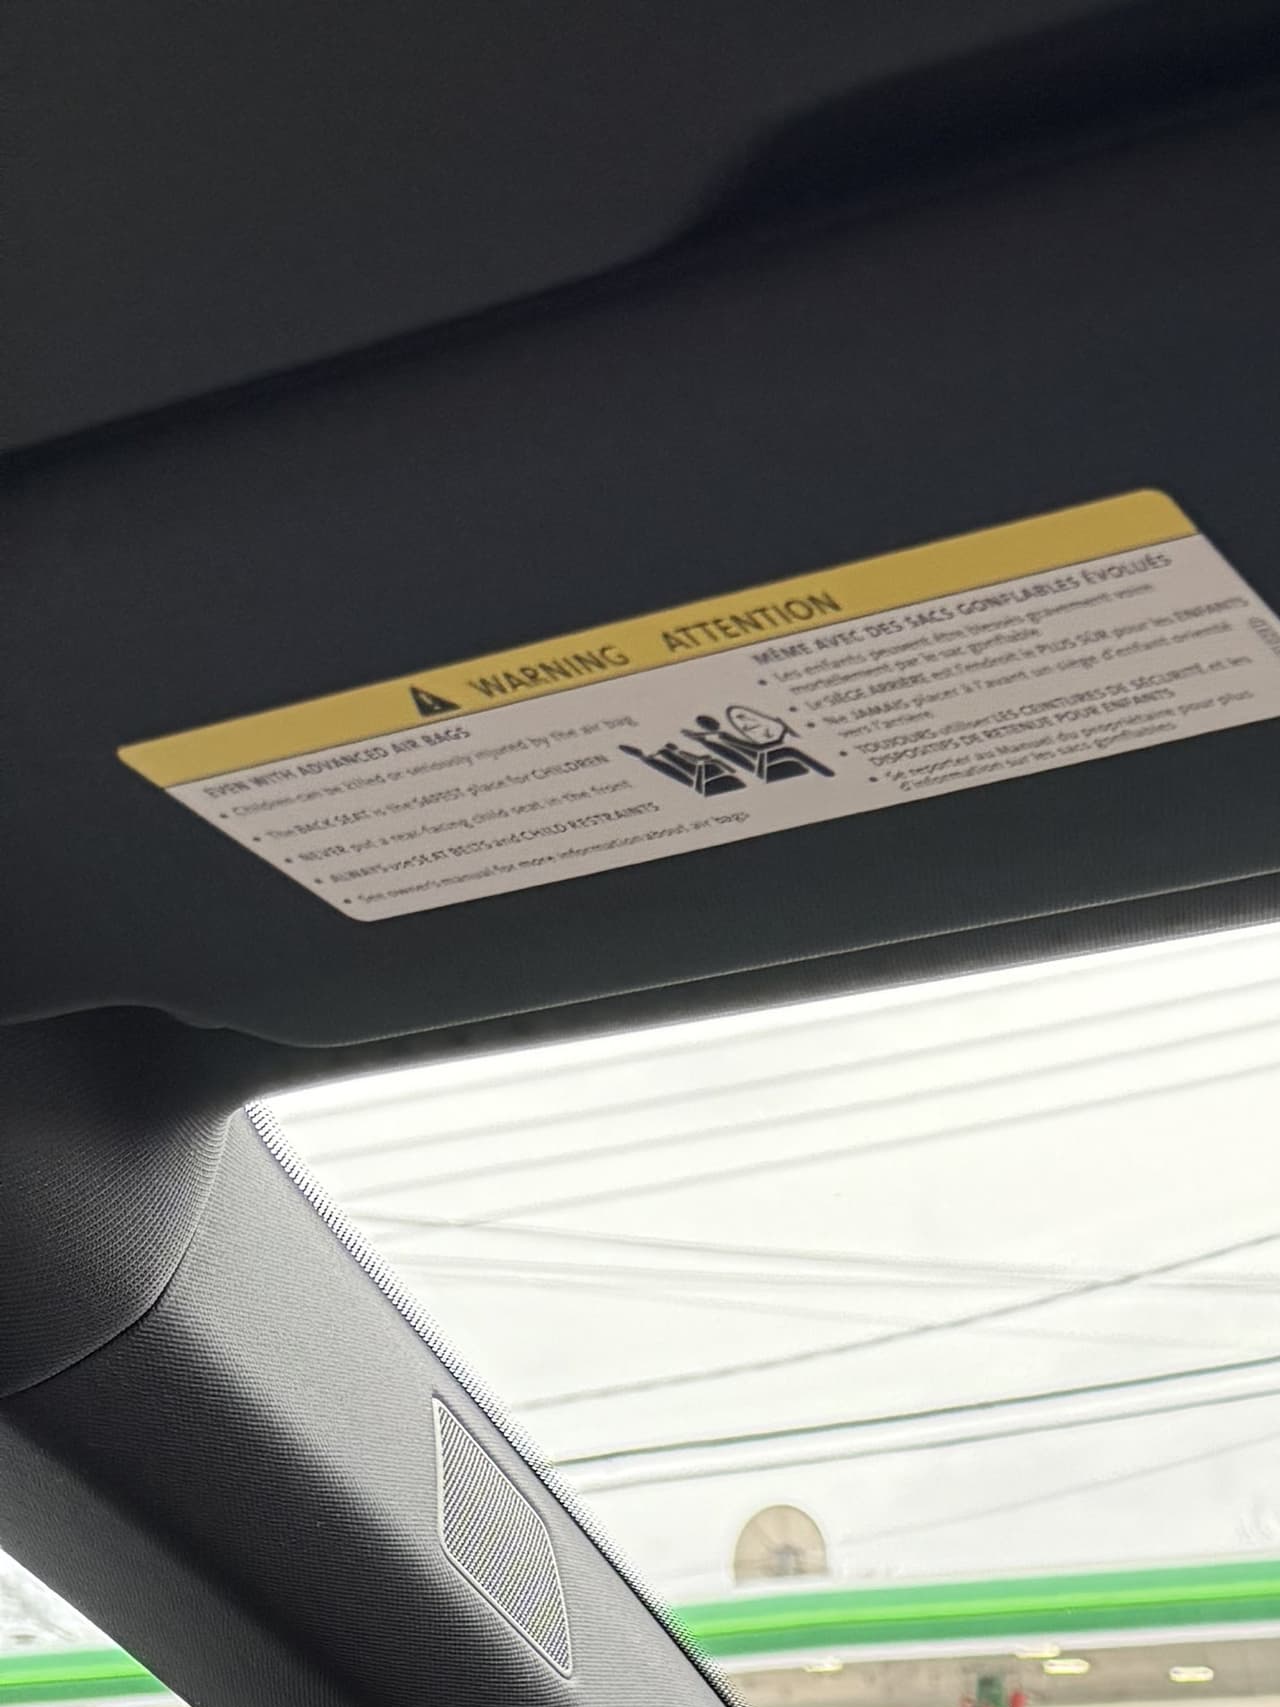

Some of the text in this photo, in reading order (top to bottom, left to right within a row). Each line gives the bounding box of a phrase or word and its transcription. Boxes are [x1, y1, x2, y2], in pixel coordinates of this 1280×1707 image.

[470, 591, 843, 700] WARNING ATTENTION
[814, 629, 865, 651] AVEC
[863, 619, 904, 638] DES
[904, 607, 955, 628] SACS
[956, 576, 1081, 616] GONFLABLES
[203, 727, 471, 799] EVEN WITH ADVANCED AIR BAGS
[530, 754, 610, 780] CHILDREN
[567, 801, 660, 830] RESTRAINTS
